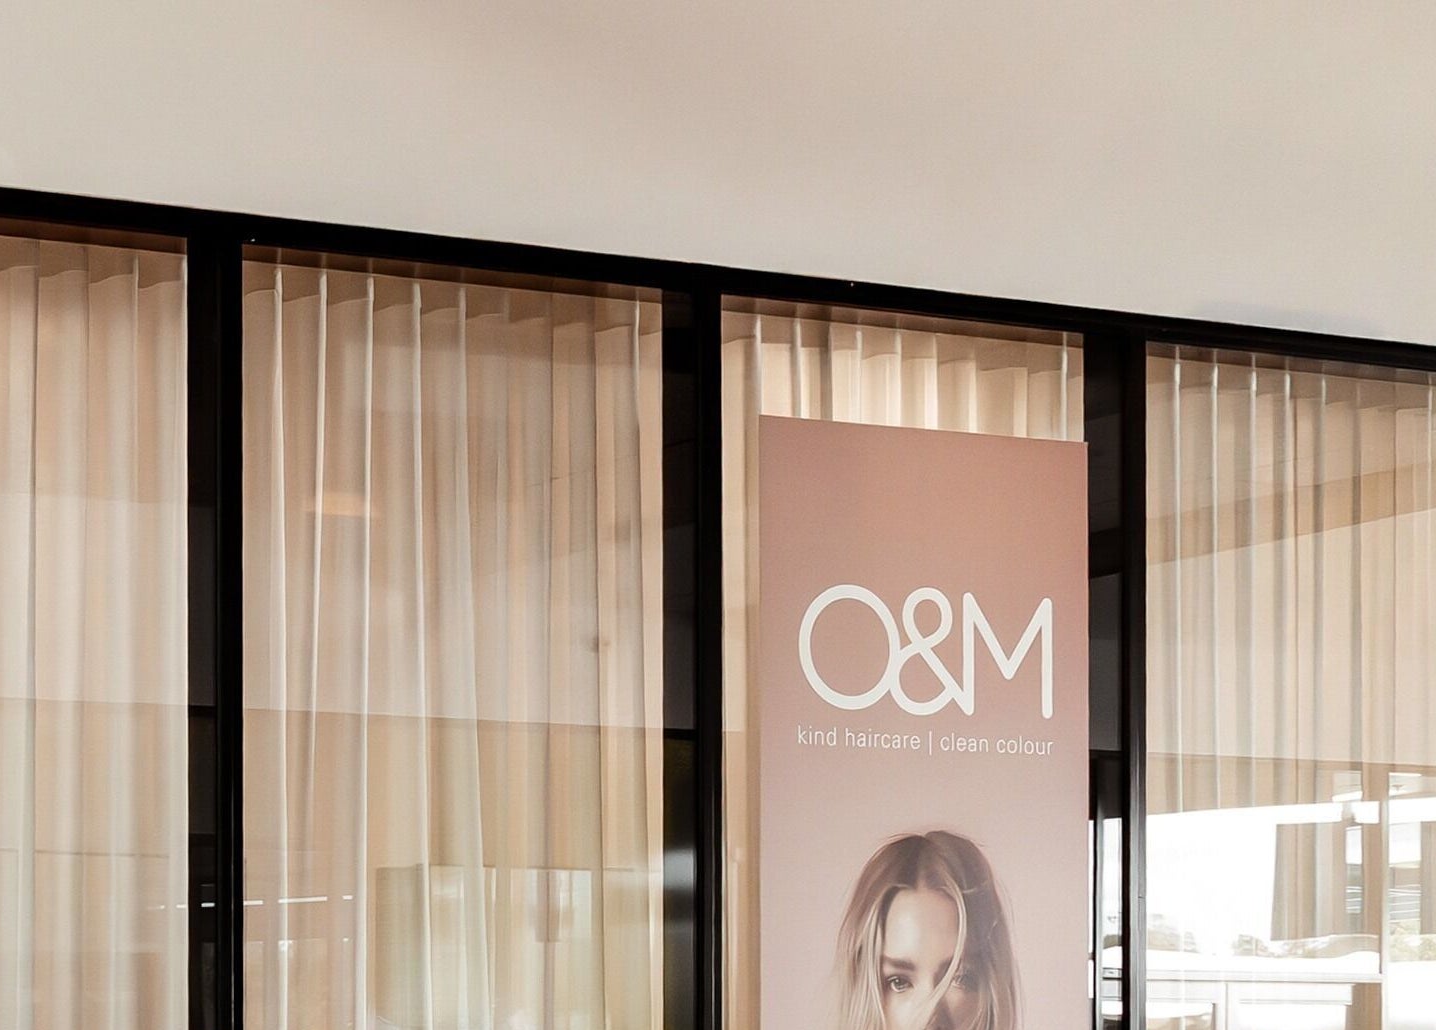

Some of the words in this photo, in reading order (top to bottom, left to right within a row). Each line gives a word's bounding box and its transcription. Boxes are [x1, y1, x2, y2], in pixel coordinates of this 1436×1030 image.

[798, 584, 1054, 719] O&M
[797, 725, 838, 747] kind
[845, 728, 922, 751] haircare
[939, 733, 990, 754] clean
[996, 737, 1055, 757] colour
